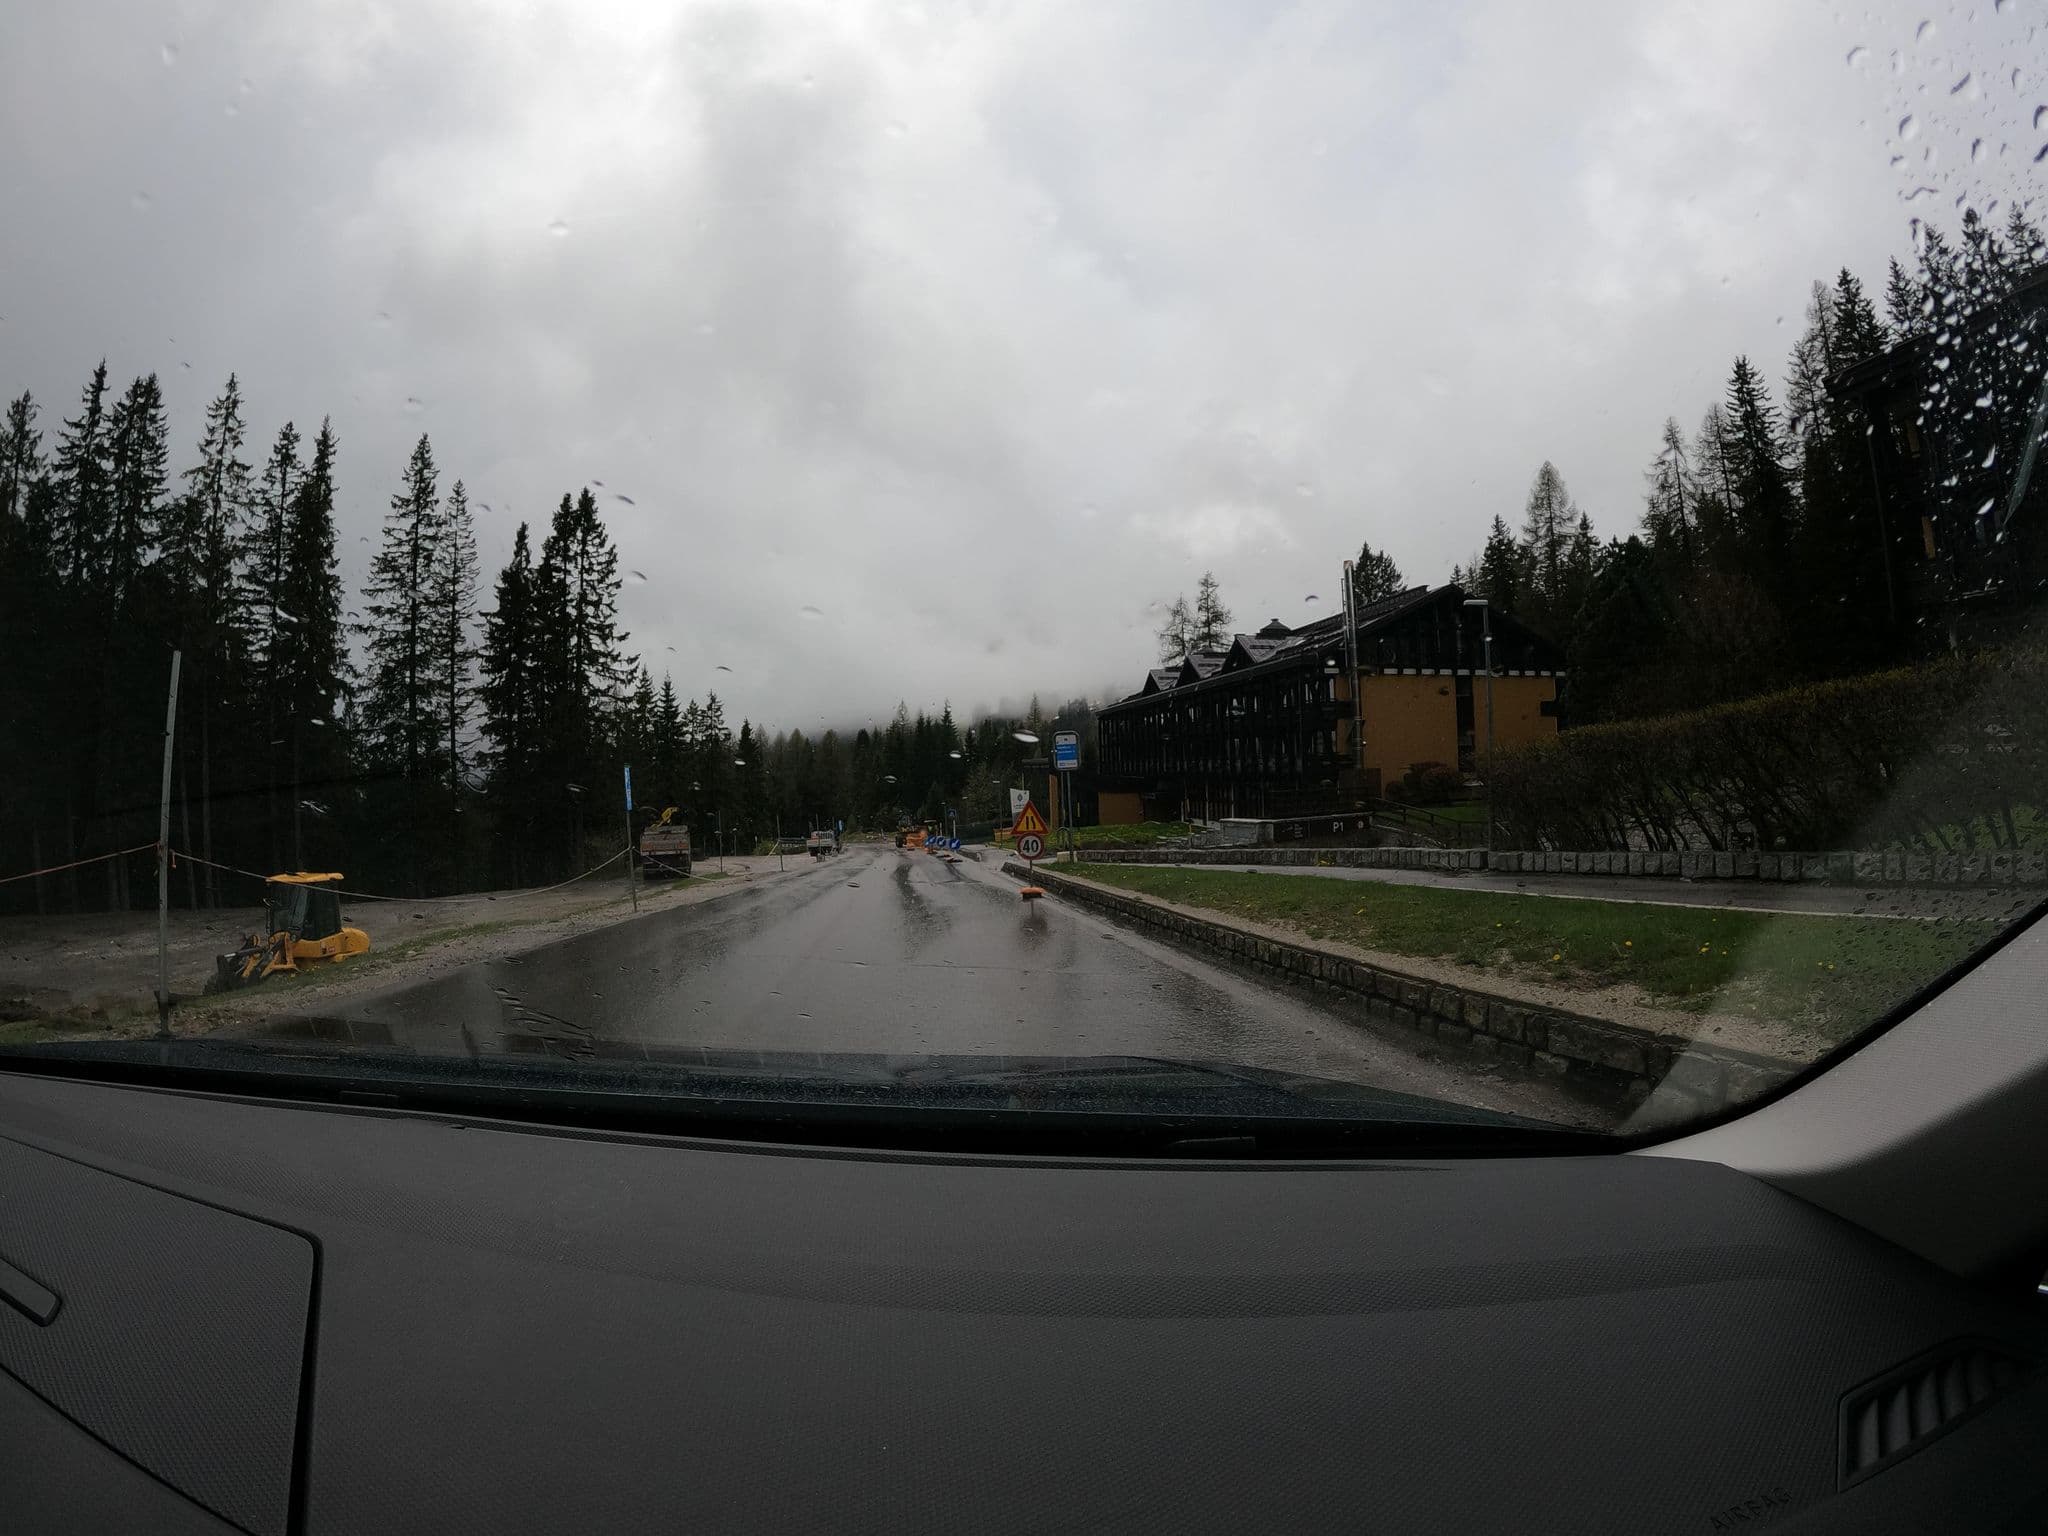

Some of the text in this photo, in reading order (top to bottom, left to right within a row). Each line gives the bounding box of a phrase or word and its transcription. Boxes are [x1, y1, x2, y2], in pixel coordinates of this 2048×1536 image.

[1333, 821, 1344, 833] P1
[1022, 839, 1039, 853] 40
[1710, 1487, 1793, 1533] AIRBAG
